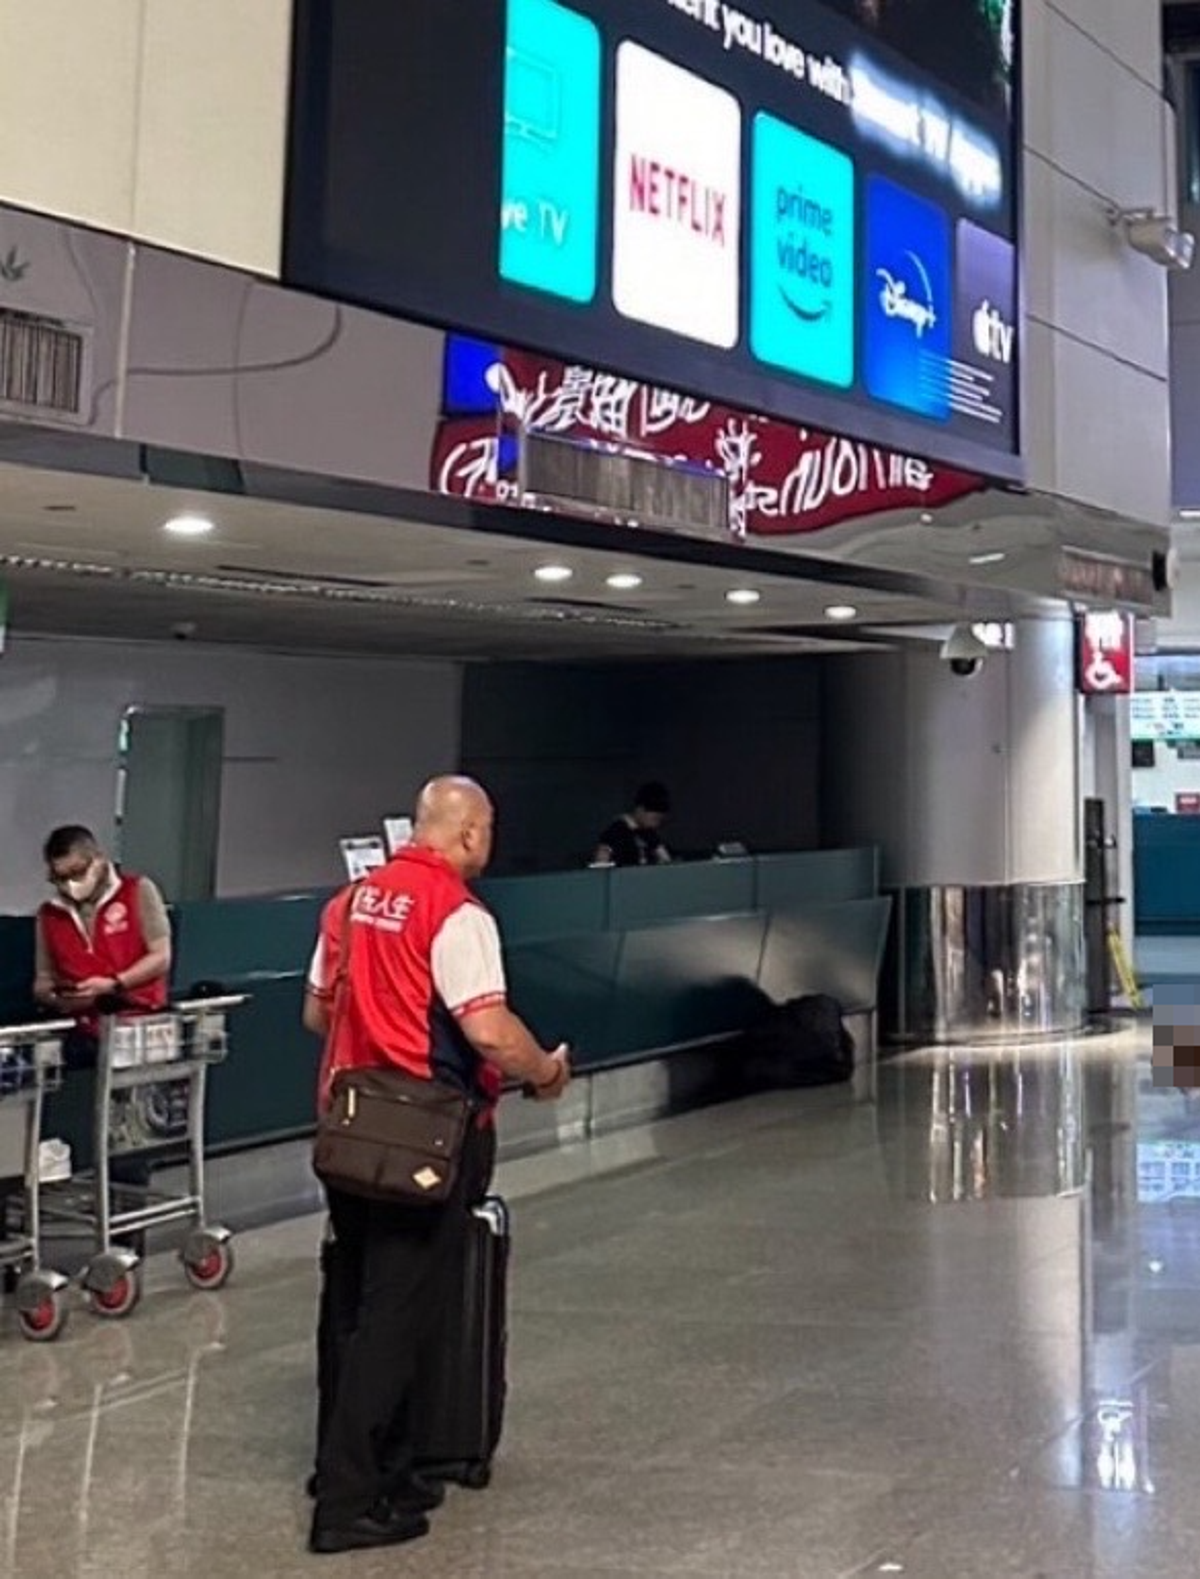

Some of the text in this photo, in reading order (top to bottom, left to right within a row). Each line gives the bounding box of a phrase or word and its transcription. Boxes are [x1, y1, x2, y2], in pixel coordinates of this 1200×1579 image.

[721, 4, 762, 49] you
[763, 22, 805, 79] love
[539, 200, 568, 246] TV
[628, 153, 725, 247] NETFLIX
[776, 184, 833, 236] prime
[776, 232, 833, 288] video
